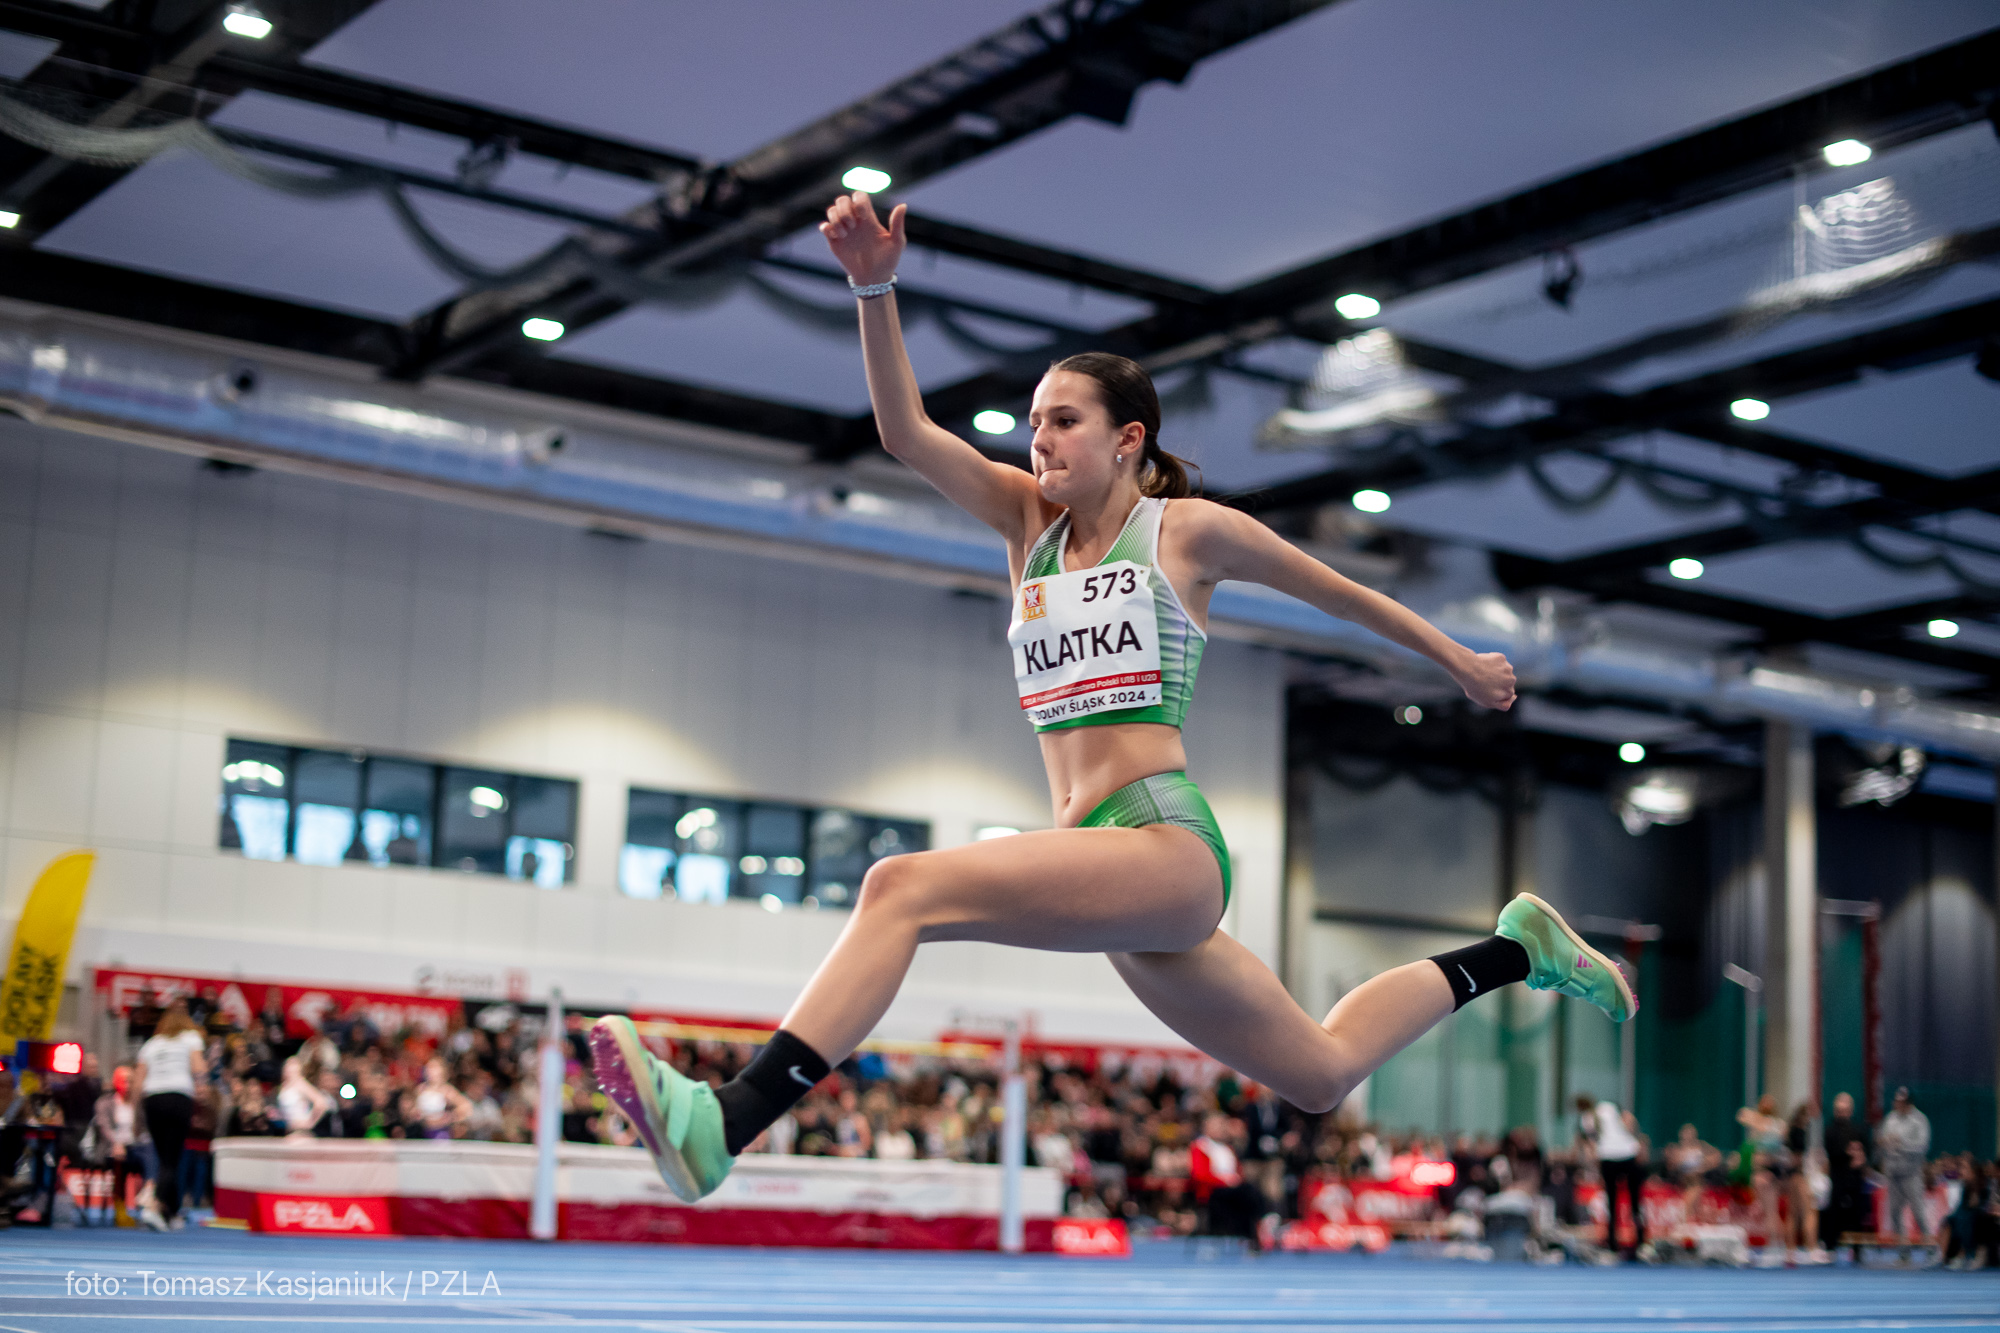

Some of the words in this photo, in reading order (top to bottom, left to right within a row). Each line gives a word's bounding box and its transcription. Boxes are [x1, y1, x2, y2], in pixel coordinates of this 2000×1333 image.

[1082, 568, 1136, 603] 573
[1023, 620, 1143, 675] KLATKA
[1096, 677, 1119, 688] Polski
[1120, 675, 1136, 684] U18
[1141, 673, 1157, 682] U20
[1069, 695, 1106, 713] ŚLĄSK
[1109, 690, 1146, 704] 2024
[273, 1199, 375, 1232] PZLA
